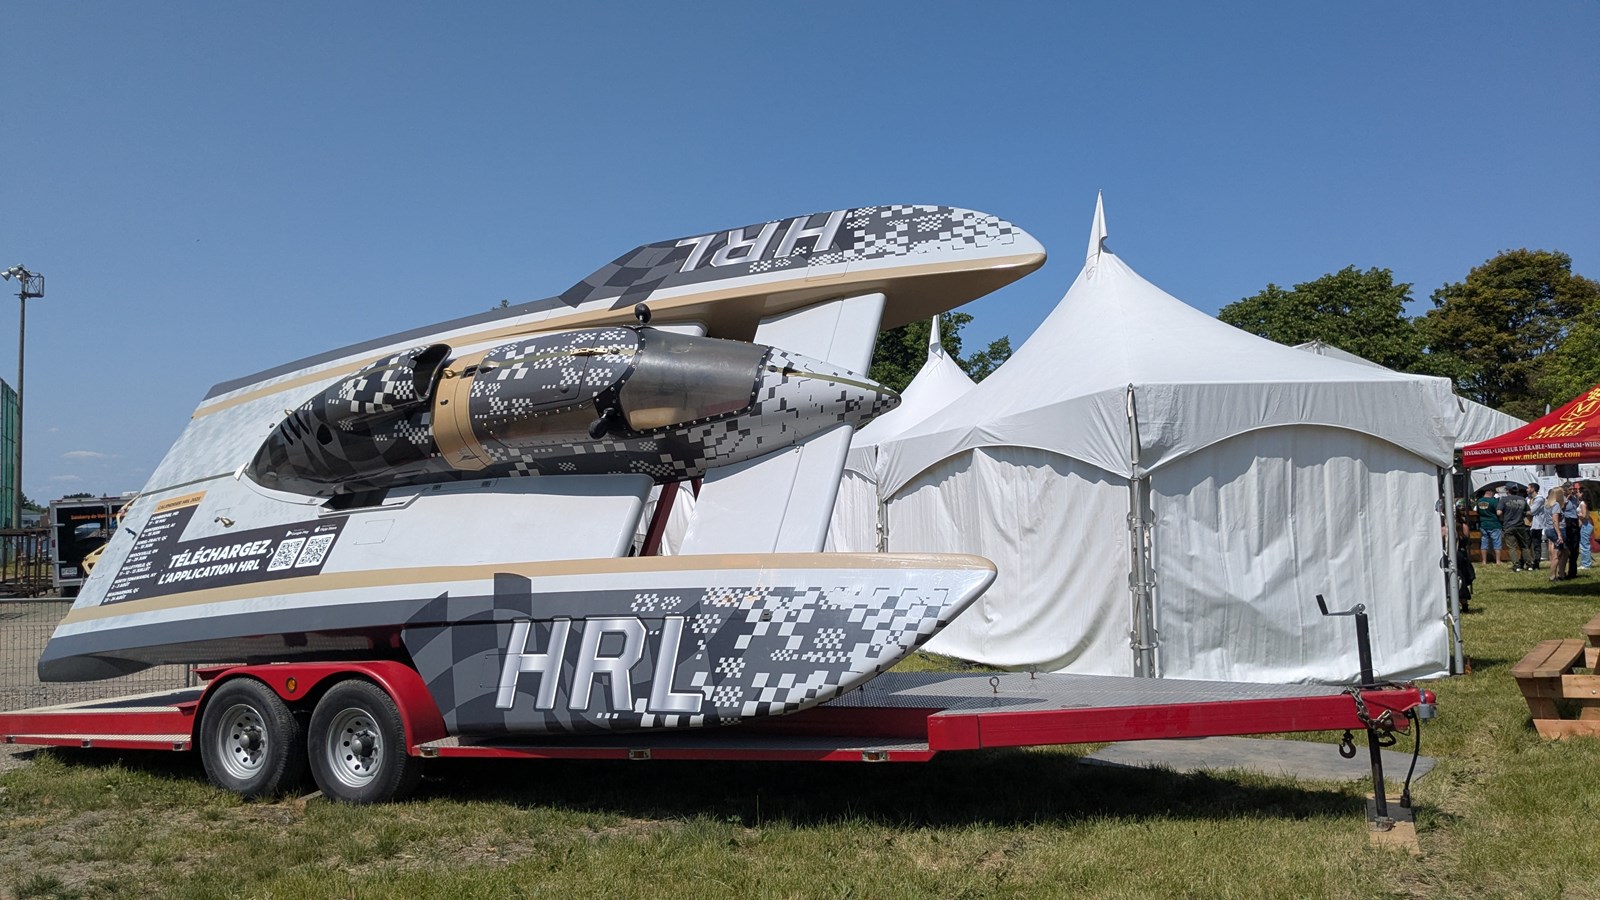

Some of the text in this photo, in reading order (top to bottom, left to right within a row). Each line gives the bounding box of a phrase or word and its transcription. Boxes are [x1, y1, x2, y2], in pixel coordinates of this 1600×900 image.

[675, 209, 848, 273] HRL
[1533, 421, 1589, 435] MIEL
[1502, 451, 1581, 461] www.mielnature.com
[168, 539, 272, 569] TÉLÉCHARGEZ
[158, 559, 261, 585] L'APPLICATION HRL
[494, 615, 703, 713] HRL
